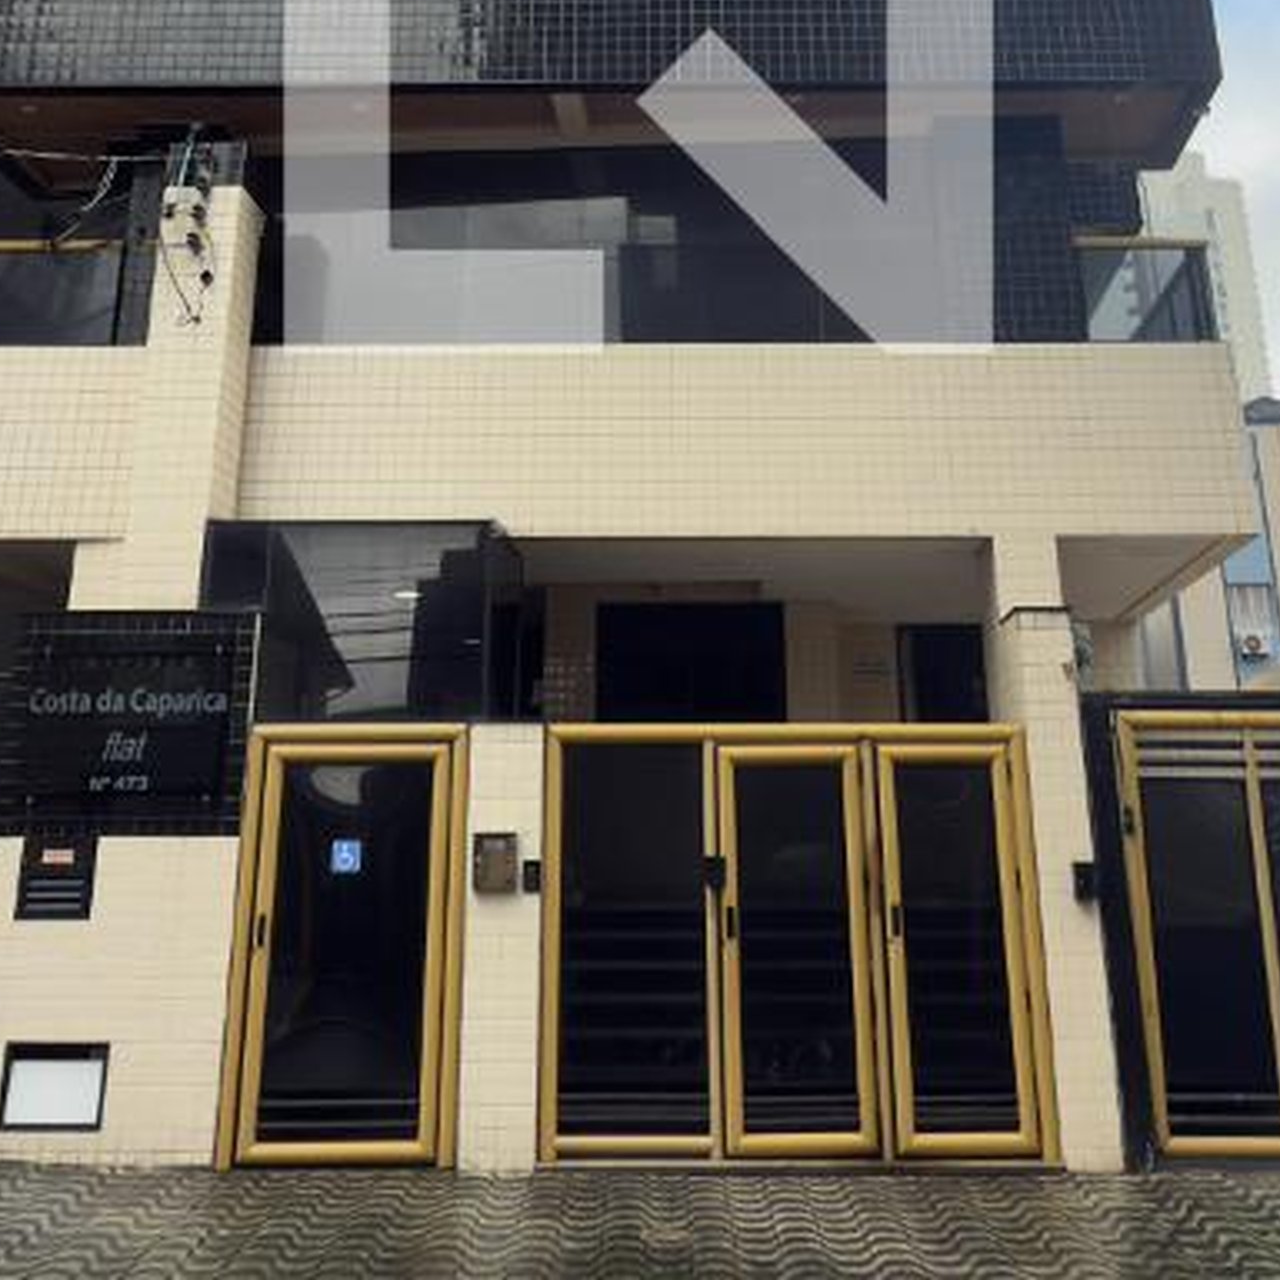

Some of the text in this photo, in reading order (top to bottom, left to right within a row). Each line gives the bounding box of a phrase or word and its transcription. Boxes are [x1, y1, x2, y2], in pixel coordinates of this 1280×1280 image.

[29, 687, 228, 718] Costa da Caparica
